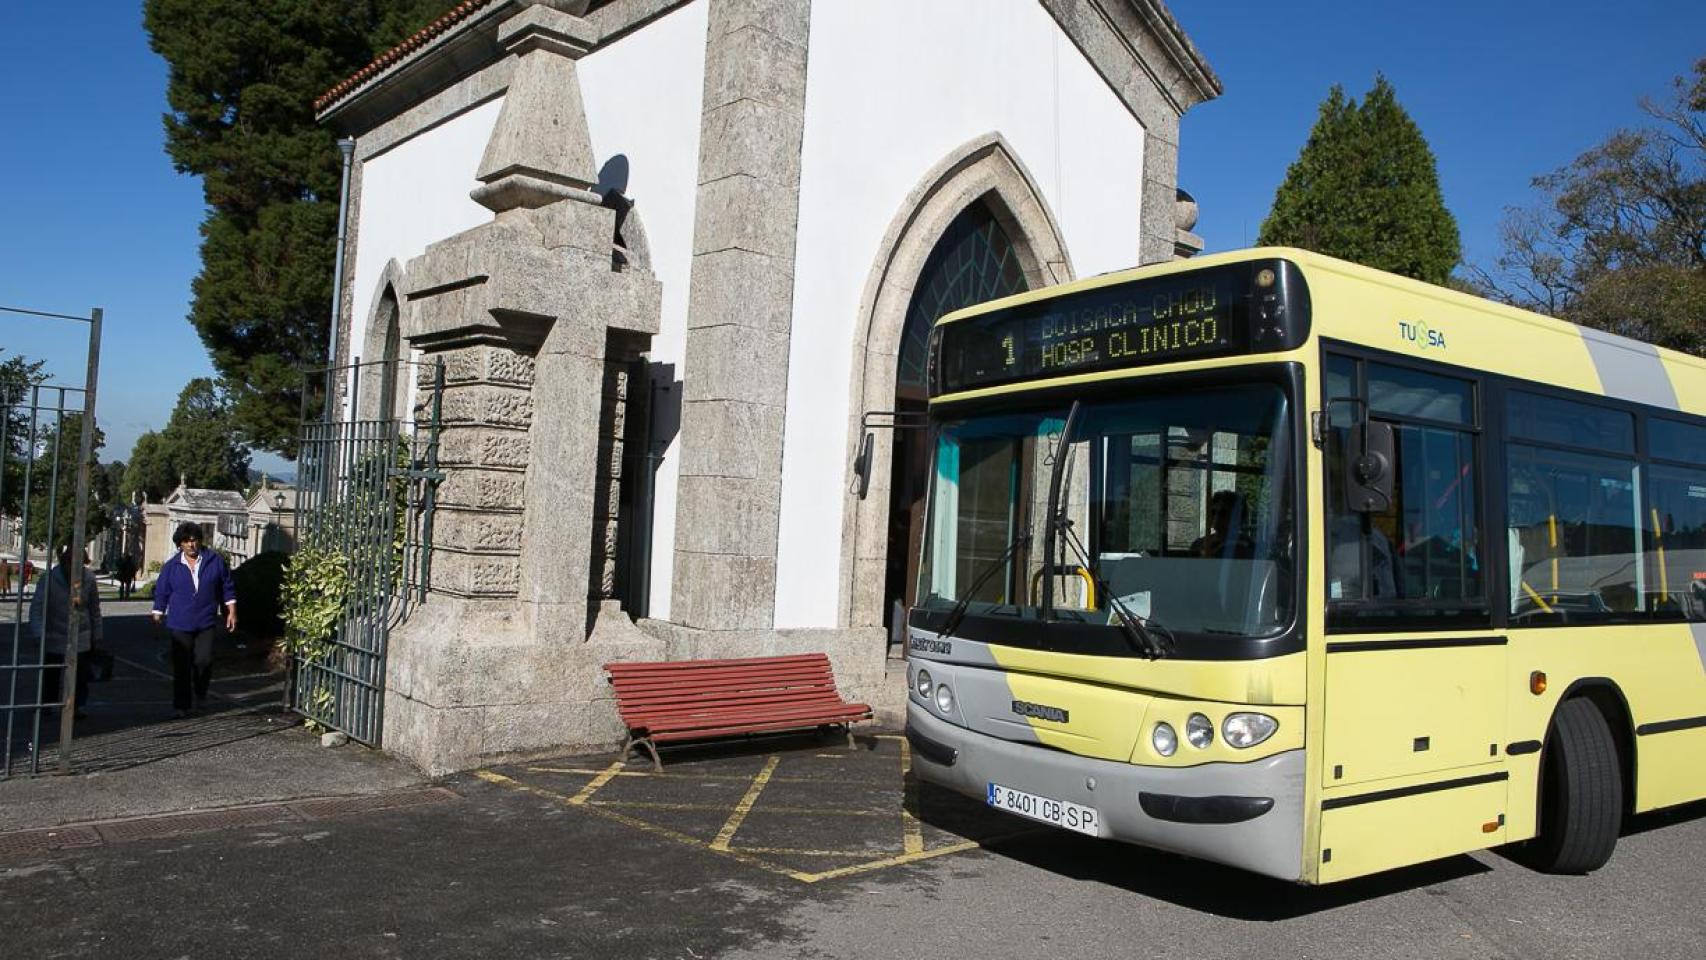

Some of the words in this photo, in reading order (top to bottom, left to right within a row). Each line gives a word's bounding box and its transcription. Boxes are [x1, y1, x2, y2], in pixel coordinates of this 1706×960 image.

[1001, 335, 1015, 365] 1
[1041, 337, 1099, 368] HOSP.
[1109, 316, 1217, 358] CLINICO
[1015, 701, 1066, 723] SCANIA
[993, 787, 1002, 805] C
[1007, 790, 1037, 816] 8401
[1043, 800, 1061, 822] CB
